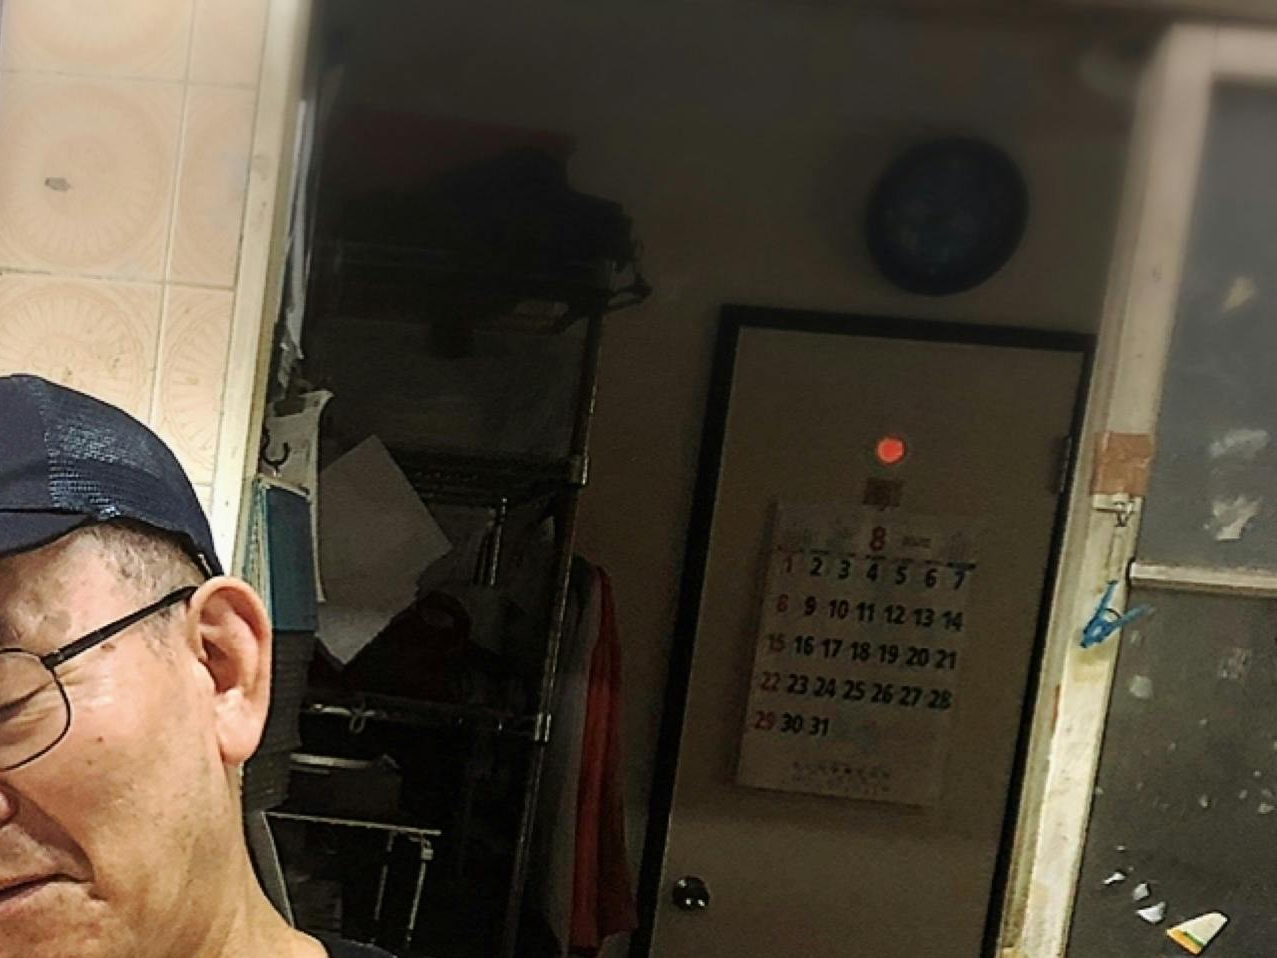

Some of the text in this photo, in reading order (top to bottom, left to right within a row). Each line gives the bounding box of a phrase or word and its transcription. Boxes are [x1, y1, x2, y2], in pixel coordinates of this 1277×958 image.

[869, 527, 886, 551] 8
[784, 555, 965, 590] 1 2 3 4 5 6 7
[804, 596, 816, 615] 9
[829, 600, 849, 619] 10
[857, 602, 875, 622] 11
[884, 605, 904, 625] 12
[914, 608, 934, 627] 13
[943, 611, 963, 632] 14
[769, 634, 956, 669] 15 16 17 18 19 20 21
[760, 672, 951, 709] 22 23 24 25 26 27 28
[755, 711, 829, 735] 29 30 31
